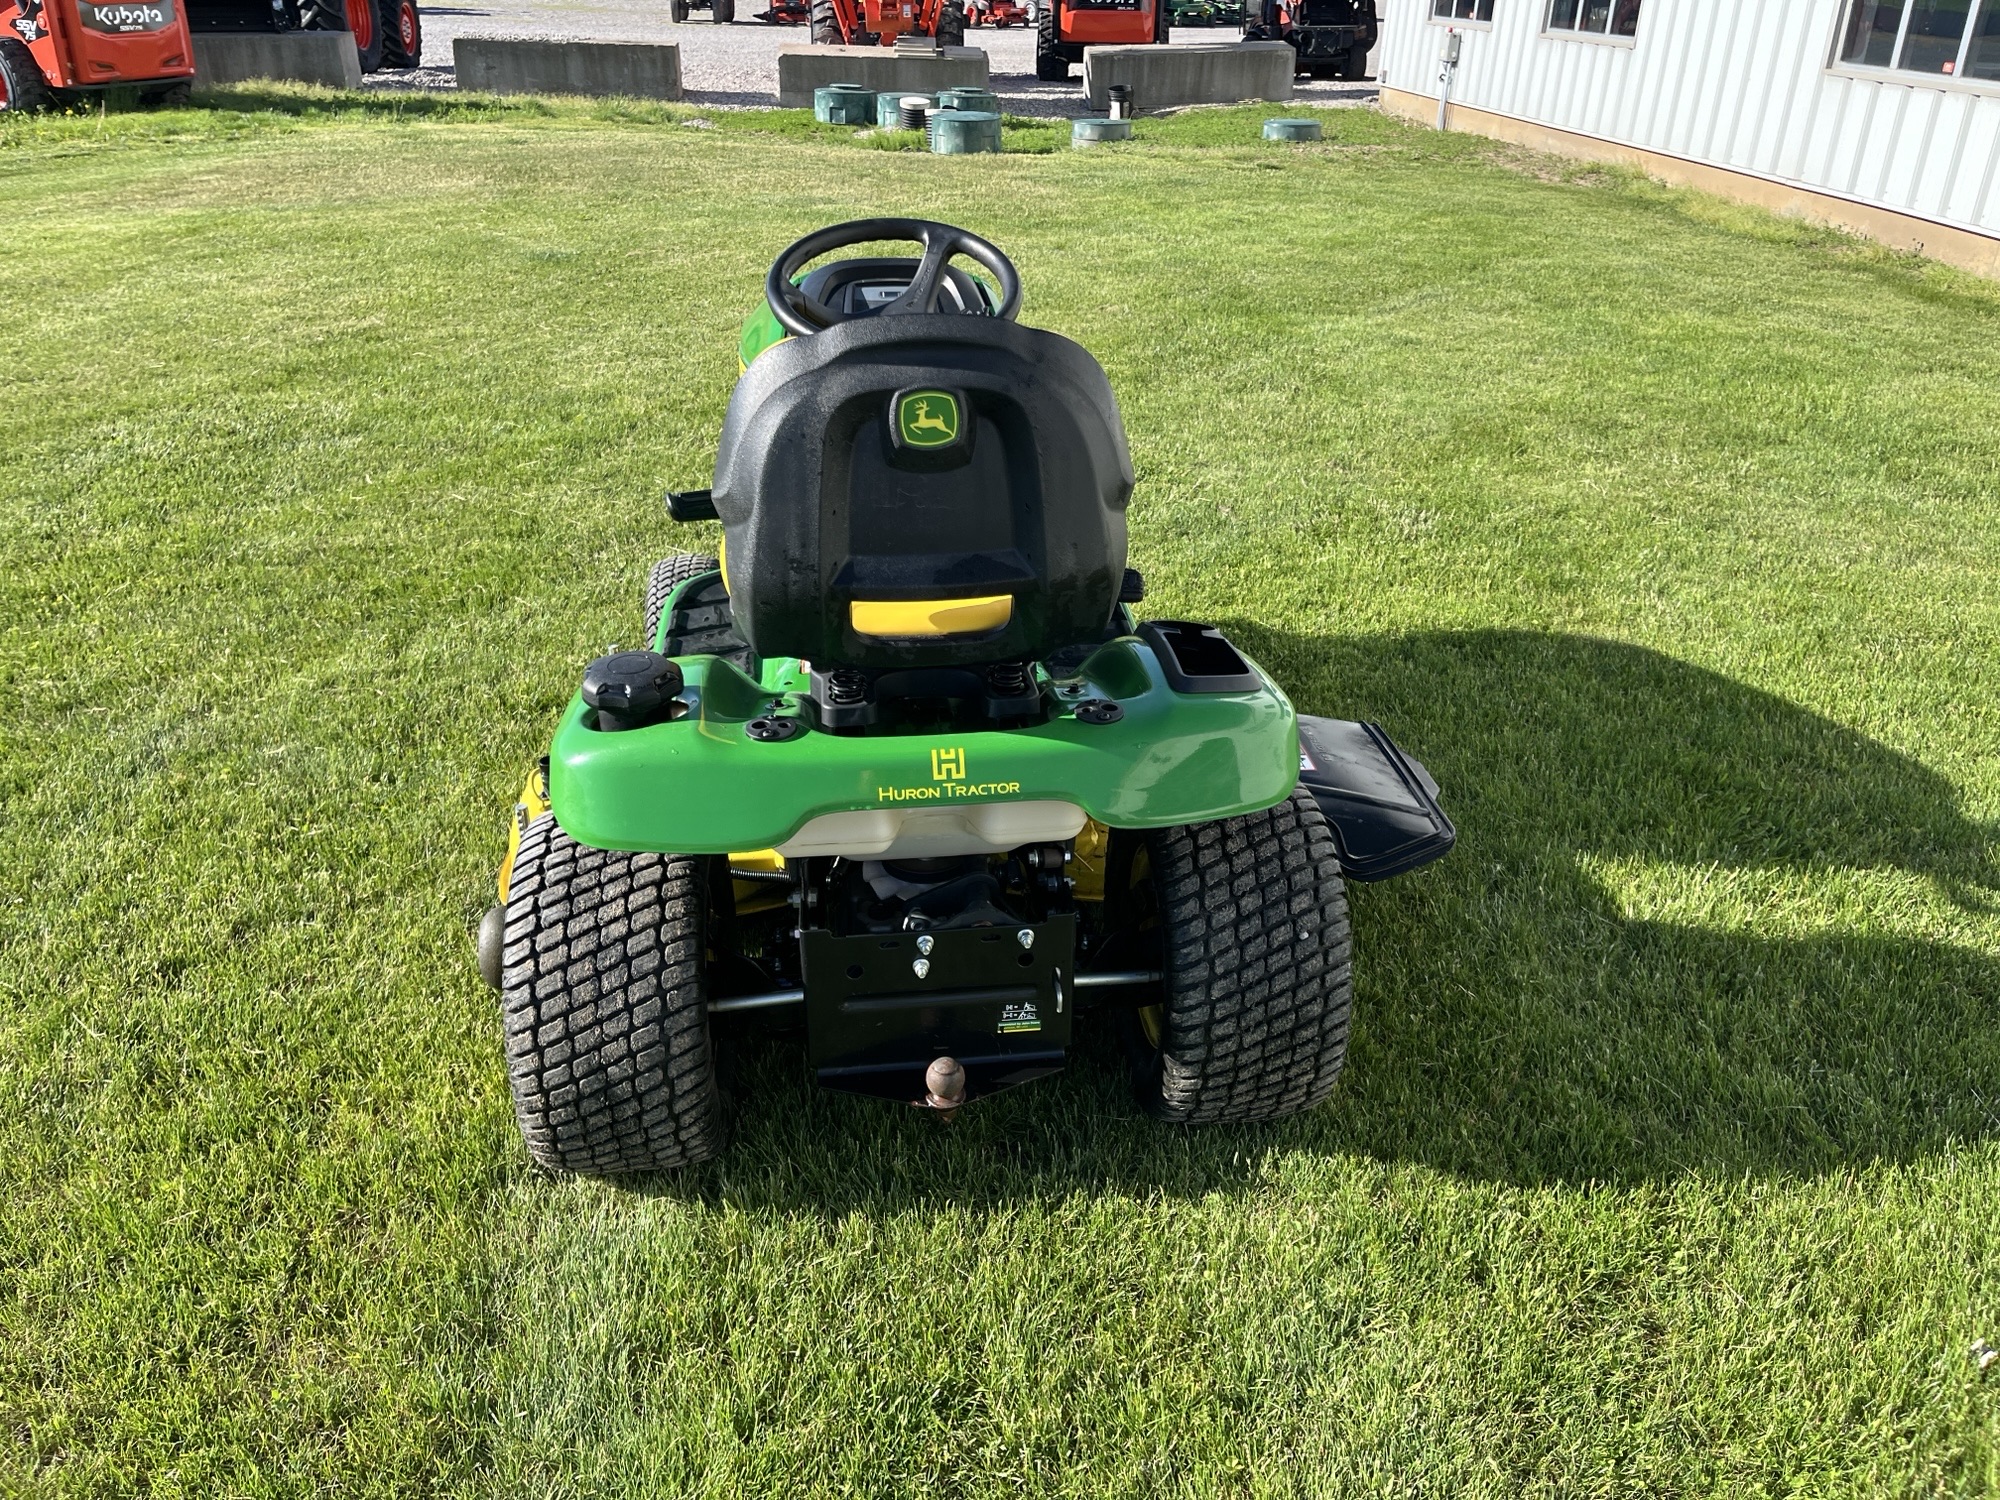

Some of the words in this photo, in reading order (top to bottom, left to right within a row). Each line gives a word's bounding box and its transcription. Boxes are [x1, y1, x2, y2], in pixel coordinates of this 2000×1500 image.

[94, 5, 162, 26] Kubota
[15, 19, 37, 31] SSV
[24, 30, 37, 41] 75
